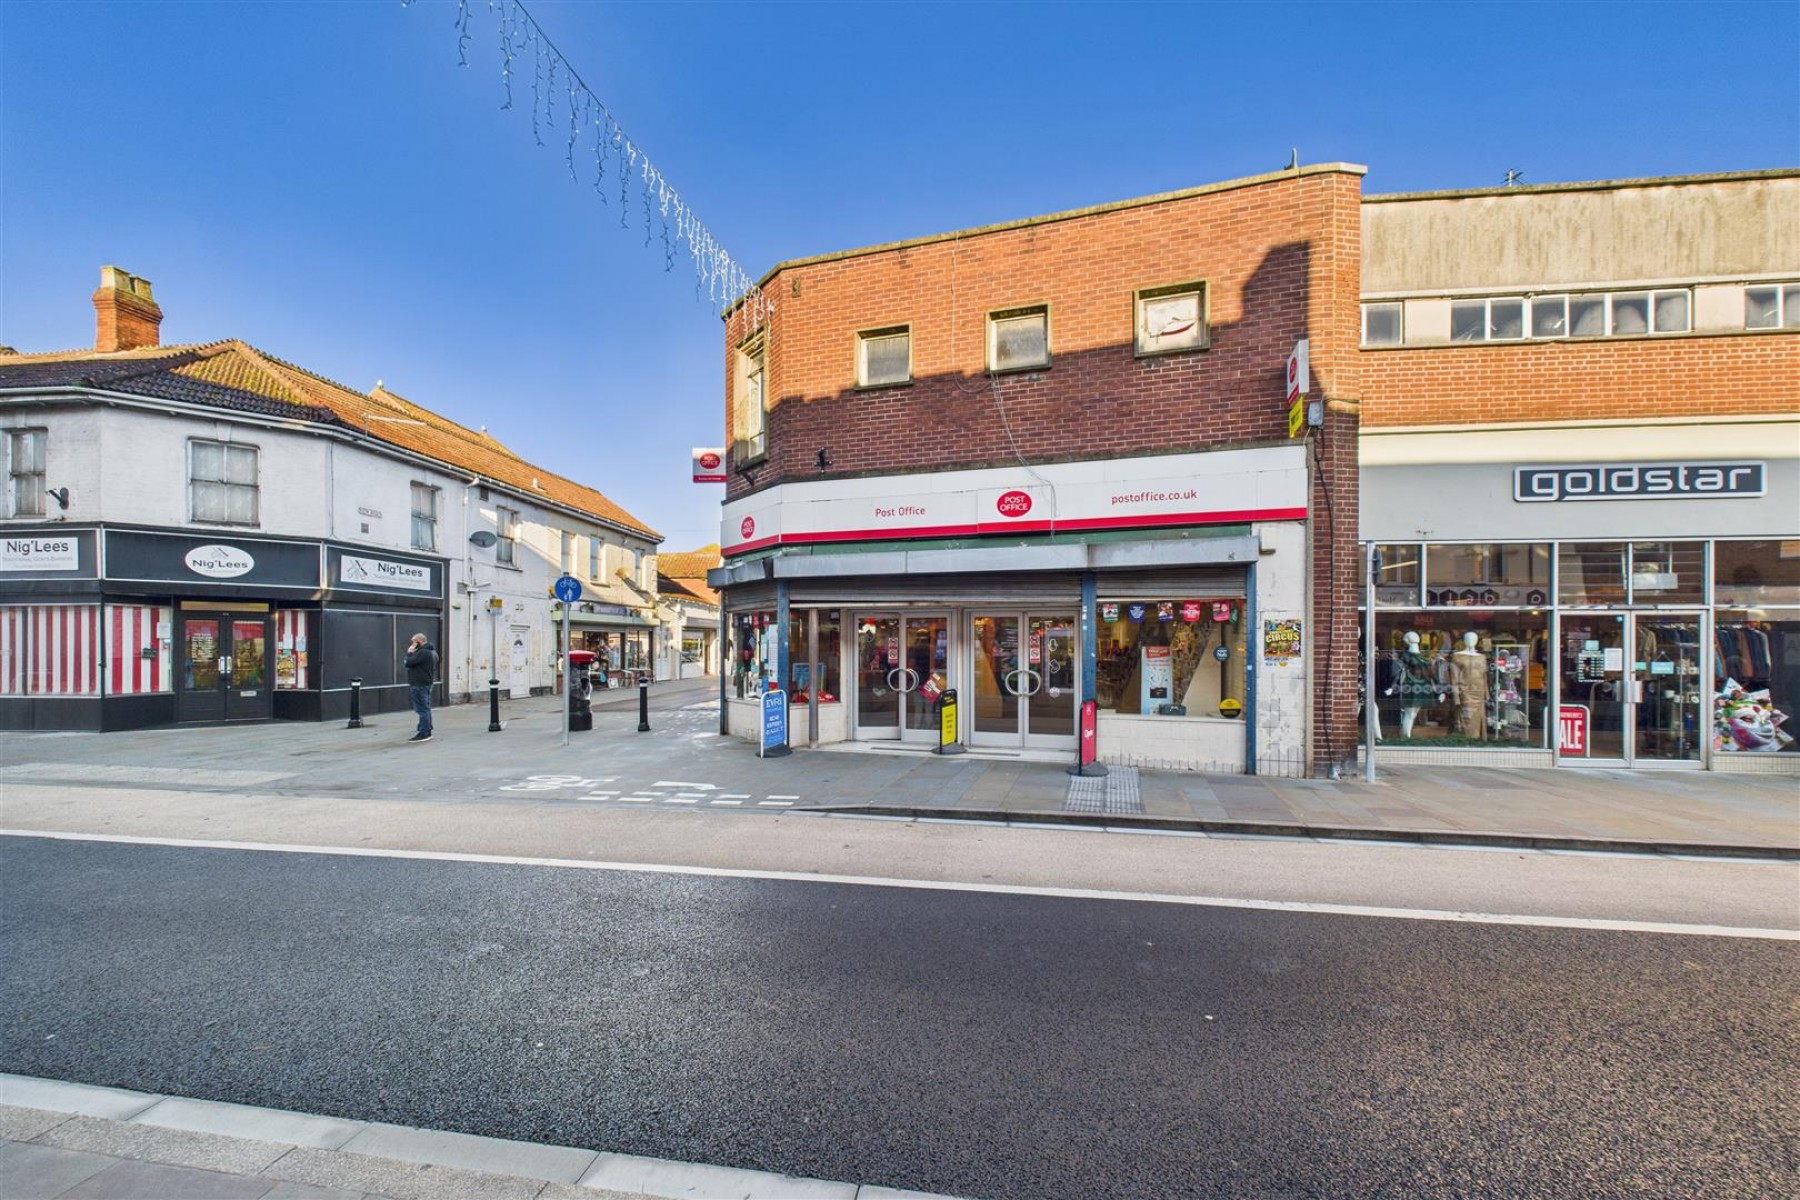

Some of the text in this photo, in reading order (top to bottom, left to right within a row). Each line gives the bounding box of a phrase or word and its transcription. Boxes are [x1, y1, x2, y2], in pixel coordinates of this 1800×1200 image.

[1532, 465, 1751, 501] goldstar
[1005, 495, 1026, 504] POST
[1111, 489, 1197, 505] postoffice.co.uk
[875, 506, 926, 517] Post Office
[1000, 502, 1029, 512] OFFICE
[1265, 631, 1300, 643] CIRCUS
[1559, 719, 1583, 750] ALE
